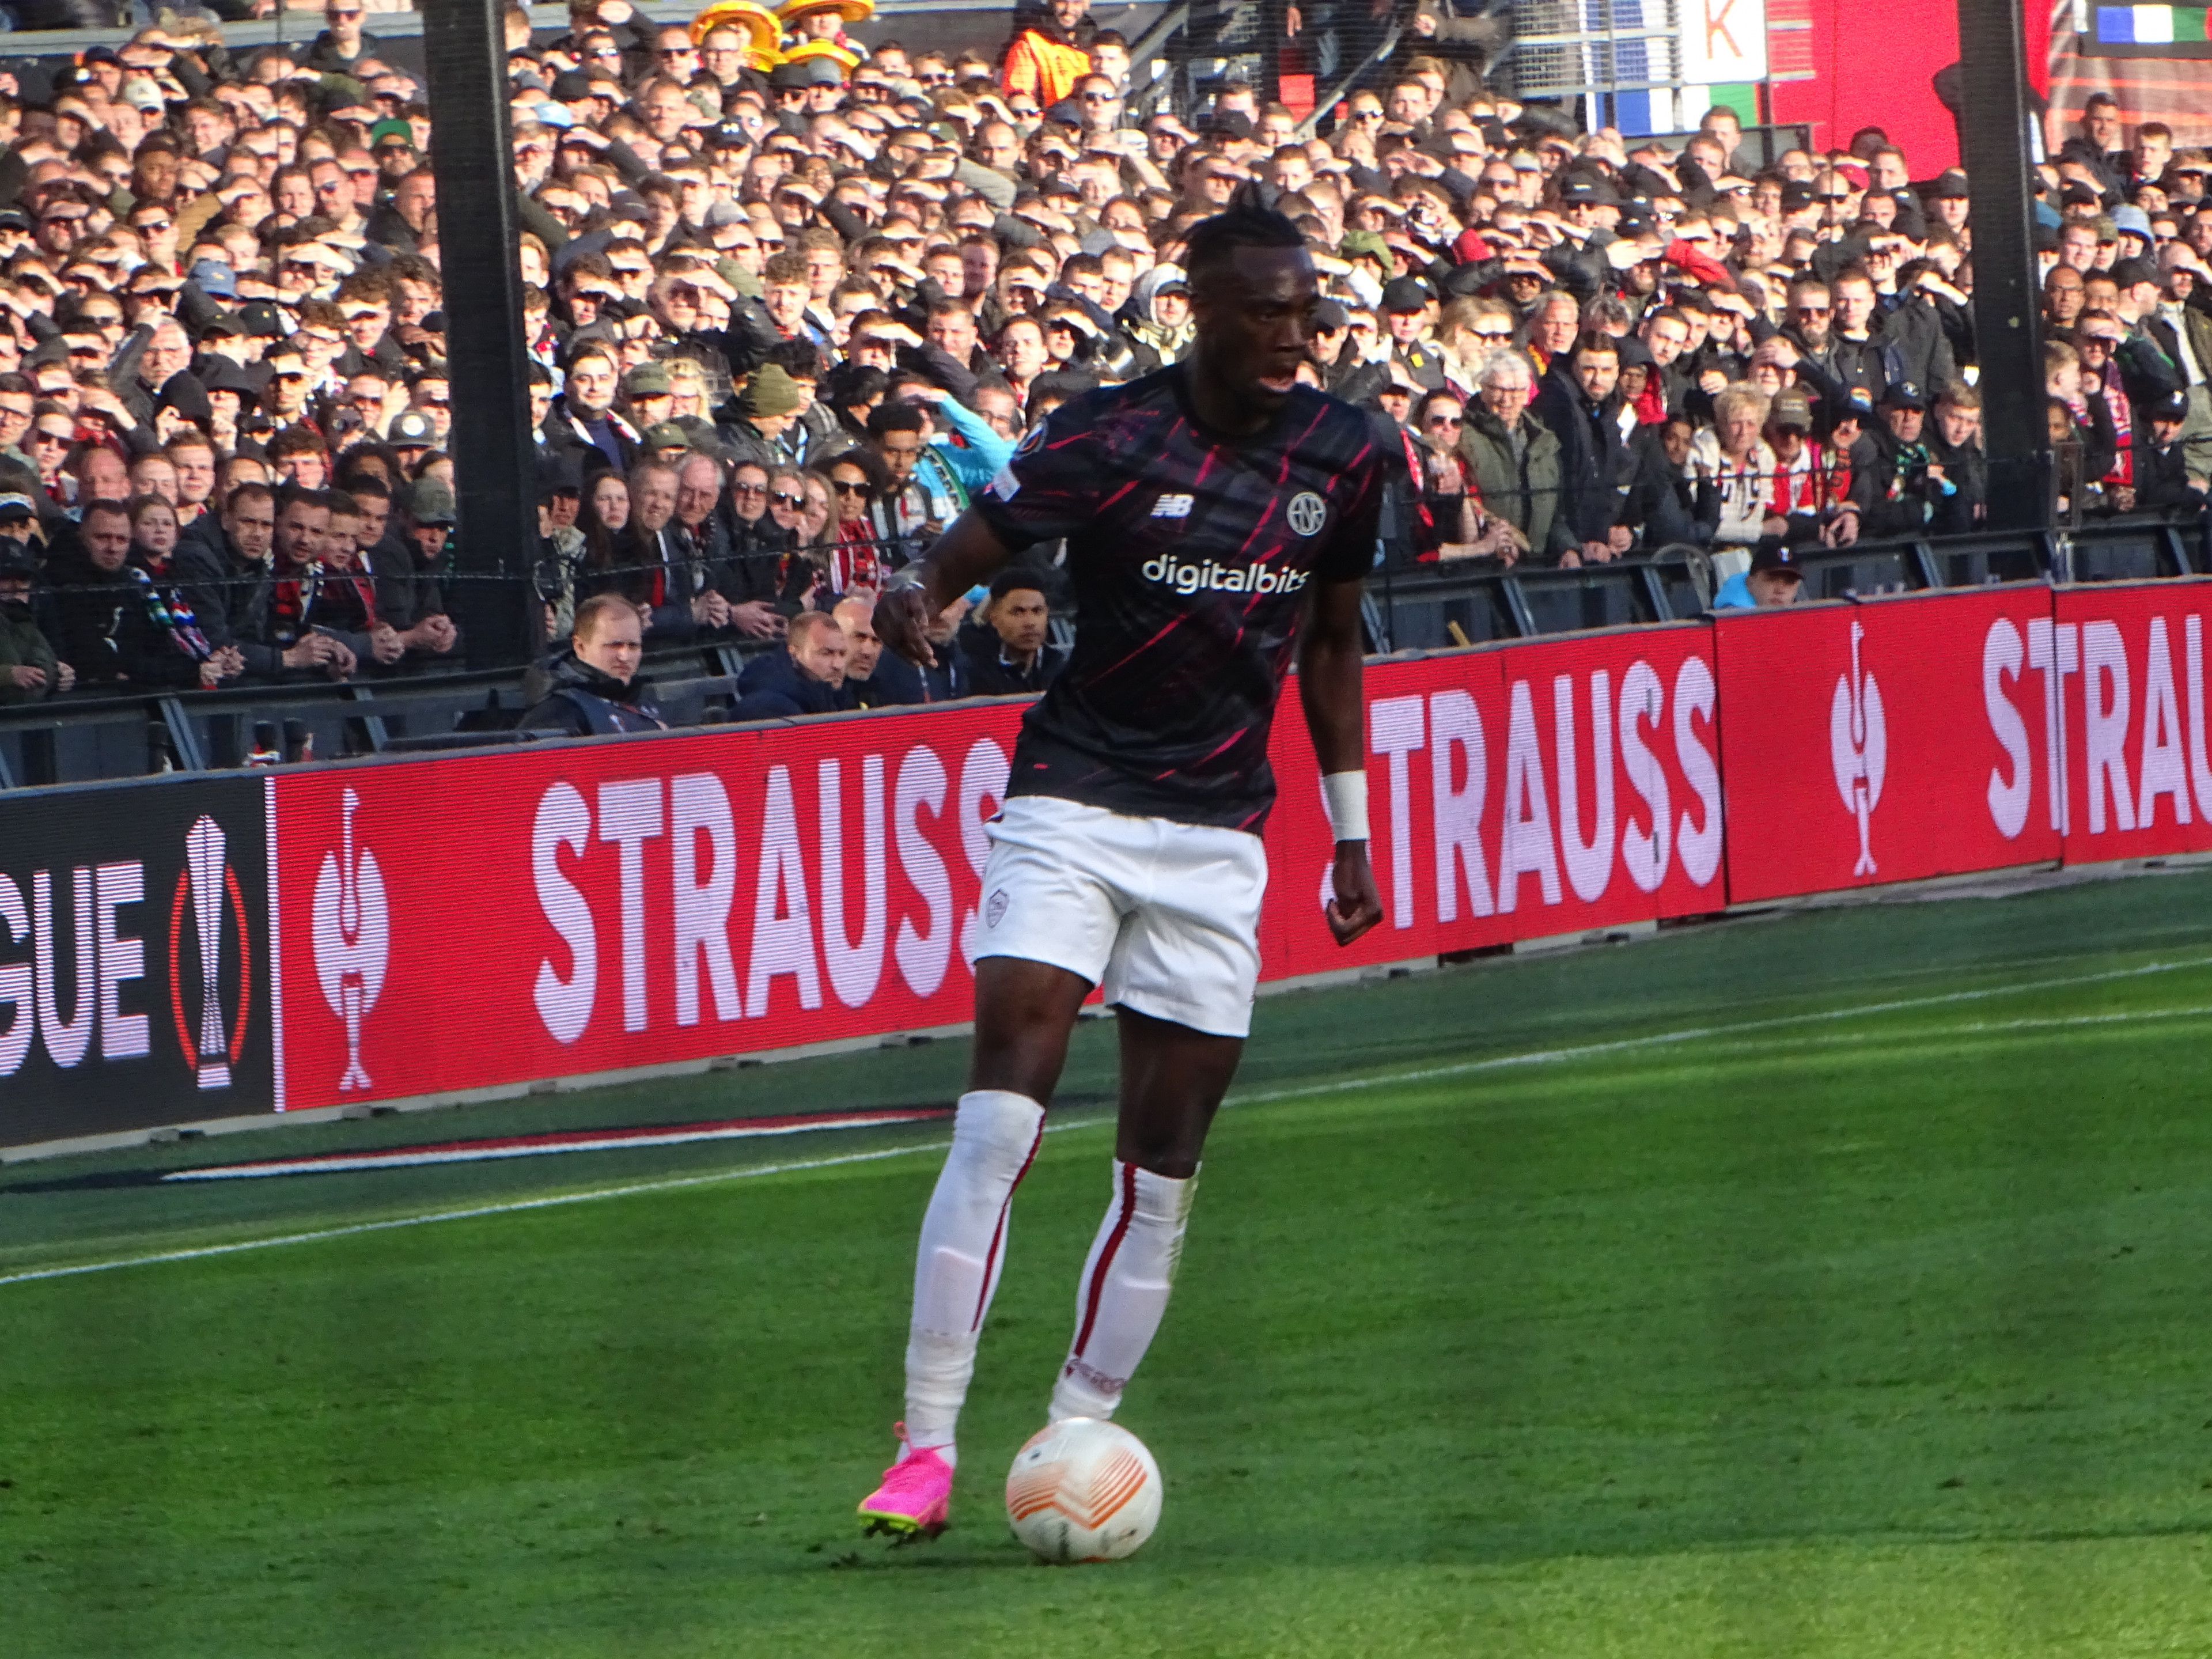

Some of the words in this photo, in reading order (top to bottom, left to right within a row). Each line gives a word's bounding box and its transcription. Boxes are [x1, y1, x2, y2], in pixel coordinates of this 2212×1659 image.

[1704, 0, 1744, 59] K
[1142, 554, 1310, 594] digitalbits
[1319, 656, 1722, 930] TRAUSS
